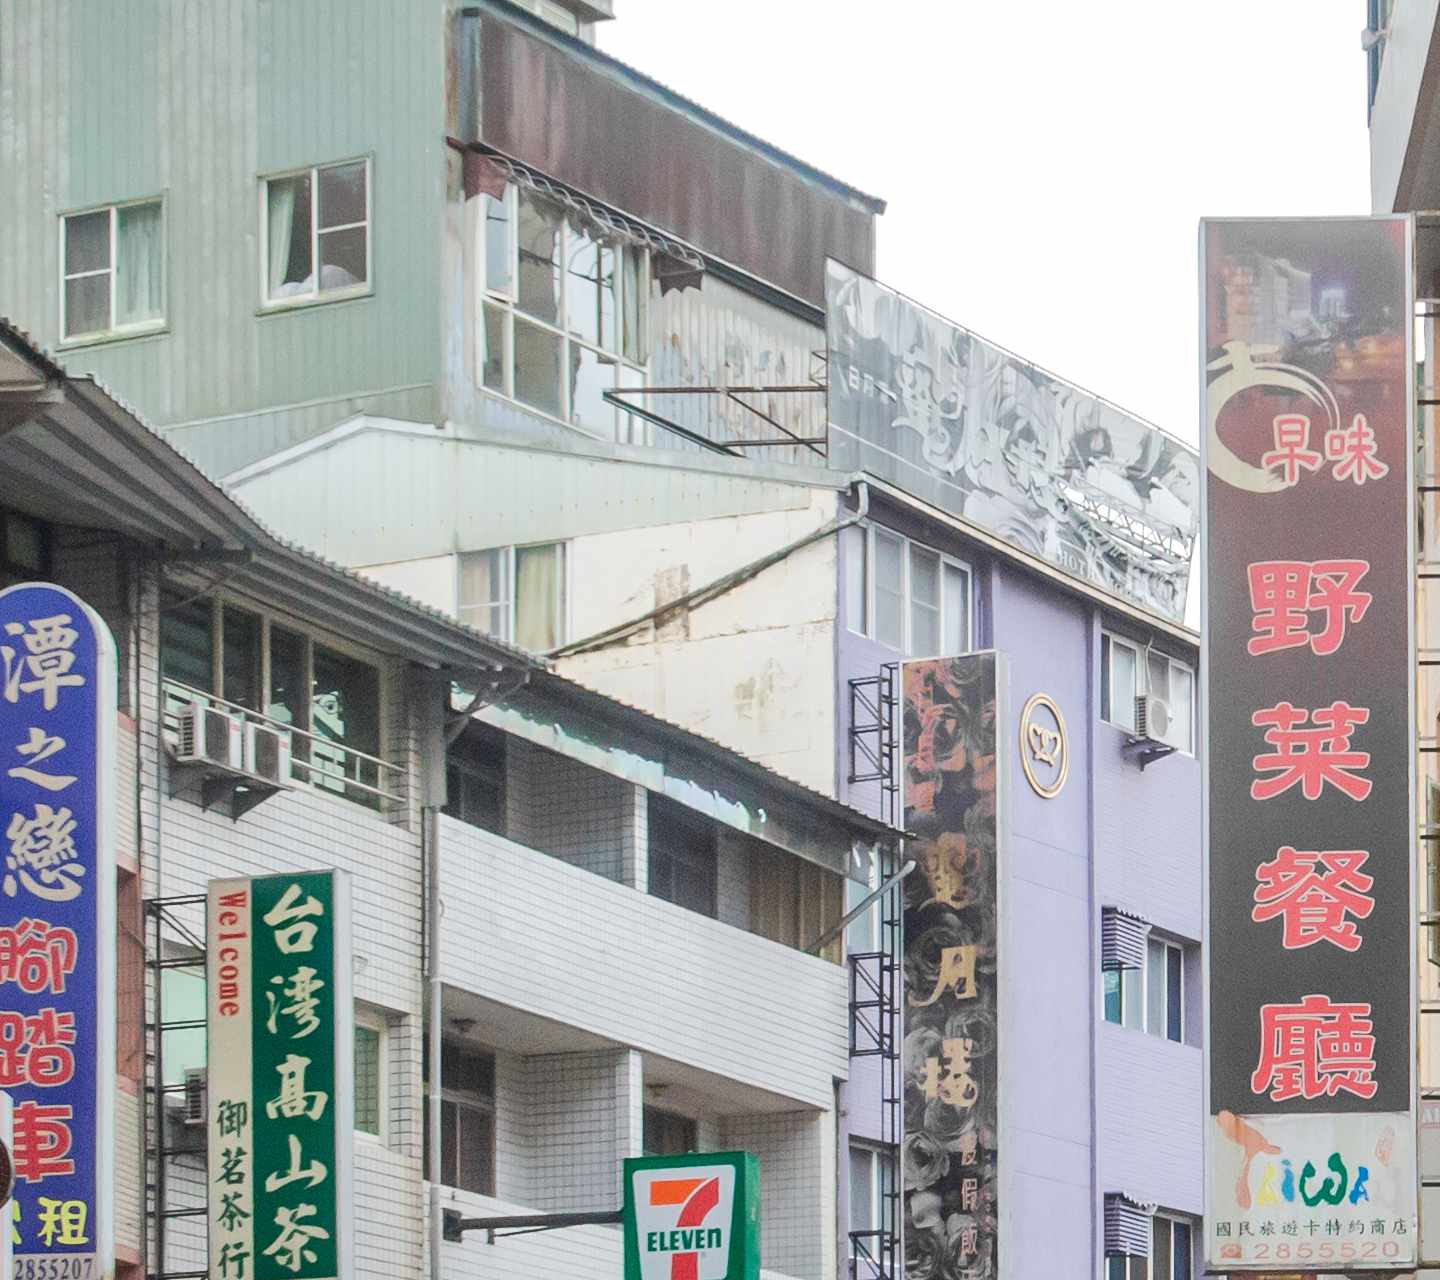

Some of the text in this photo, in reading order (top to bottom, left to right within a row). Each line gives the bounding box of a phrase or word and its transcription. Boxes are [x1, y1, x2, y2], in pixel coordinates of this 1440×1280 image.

[0, 613, 88, 901] 潭之戀
[1247, 558, 1378, 1103] 野菜餐廳
[218, 891, 246, 1018] Welcome
[1216, 1219, 1408, 1238] 國民旅遊卡特約商店
[1254, 1242, 1400, 1259] 2855520
